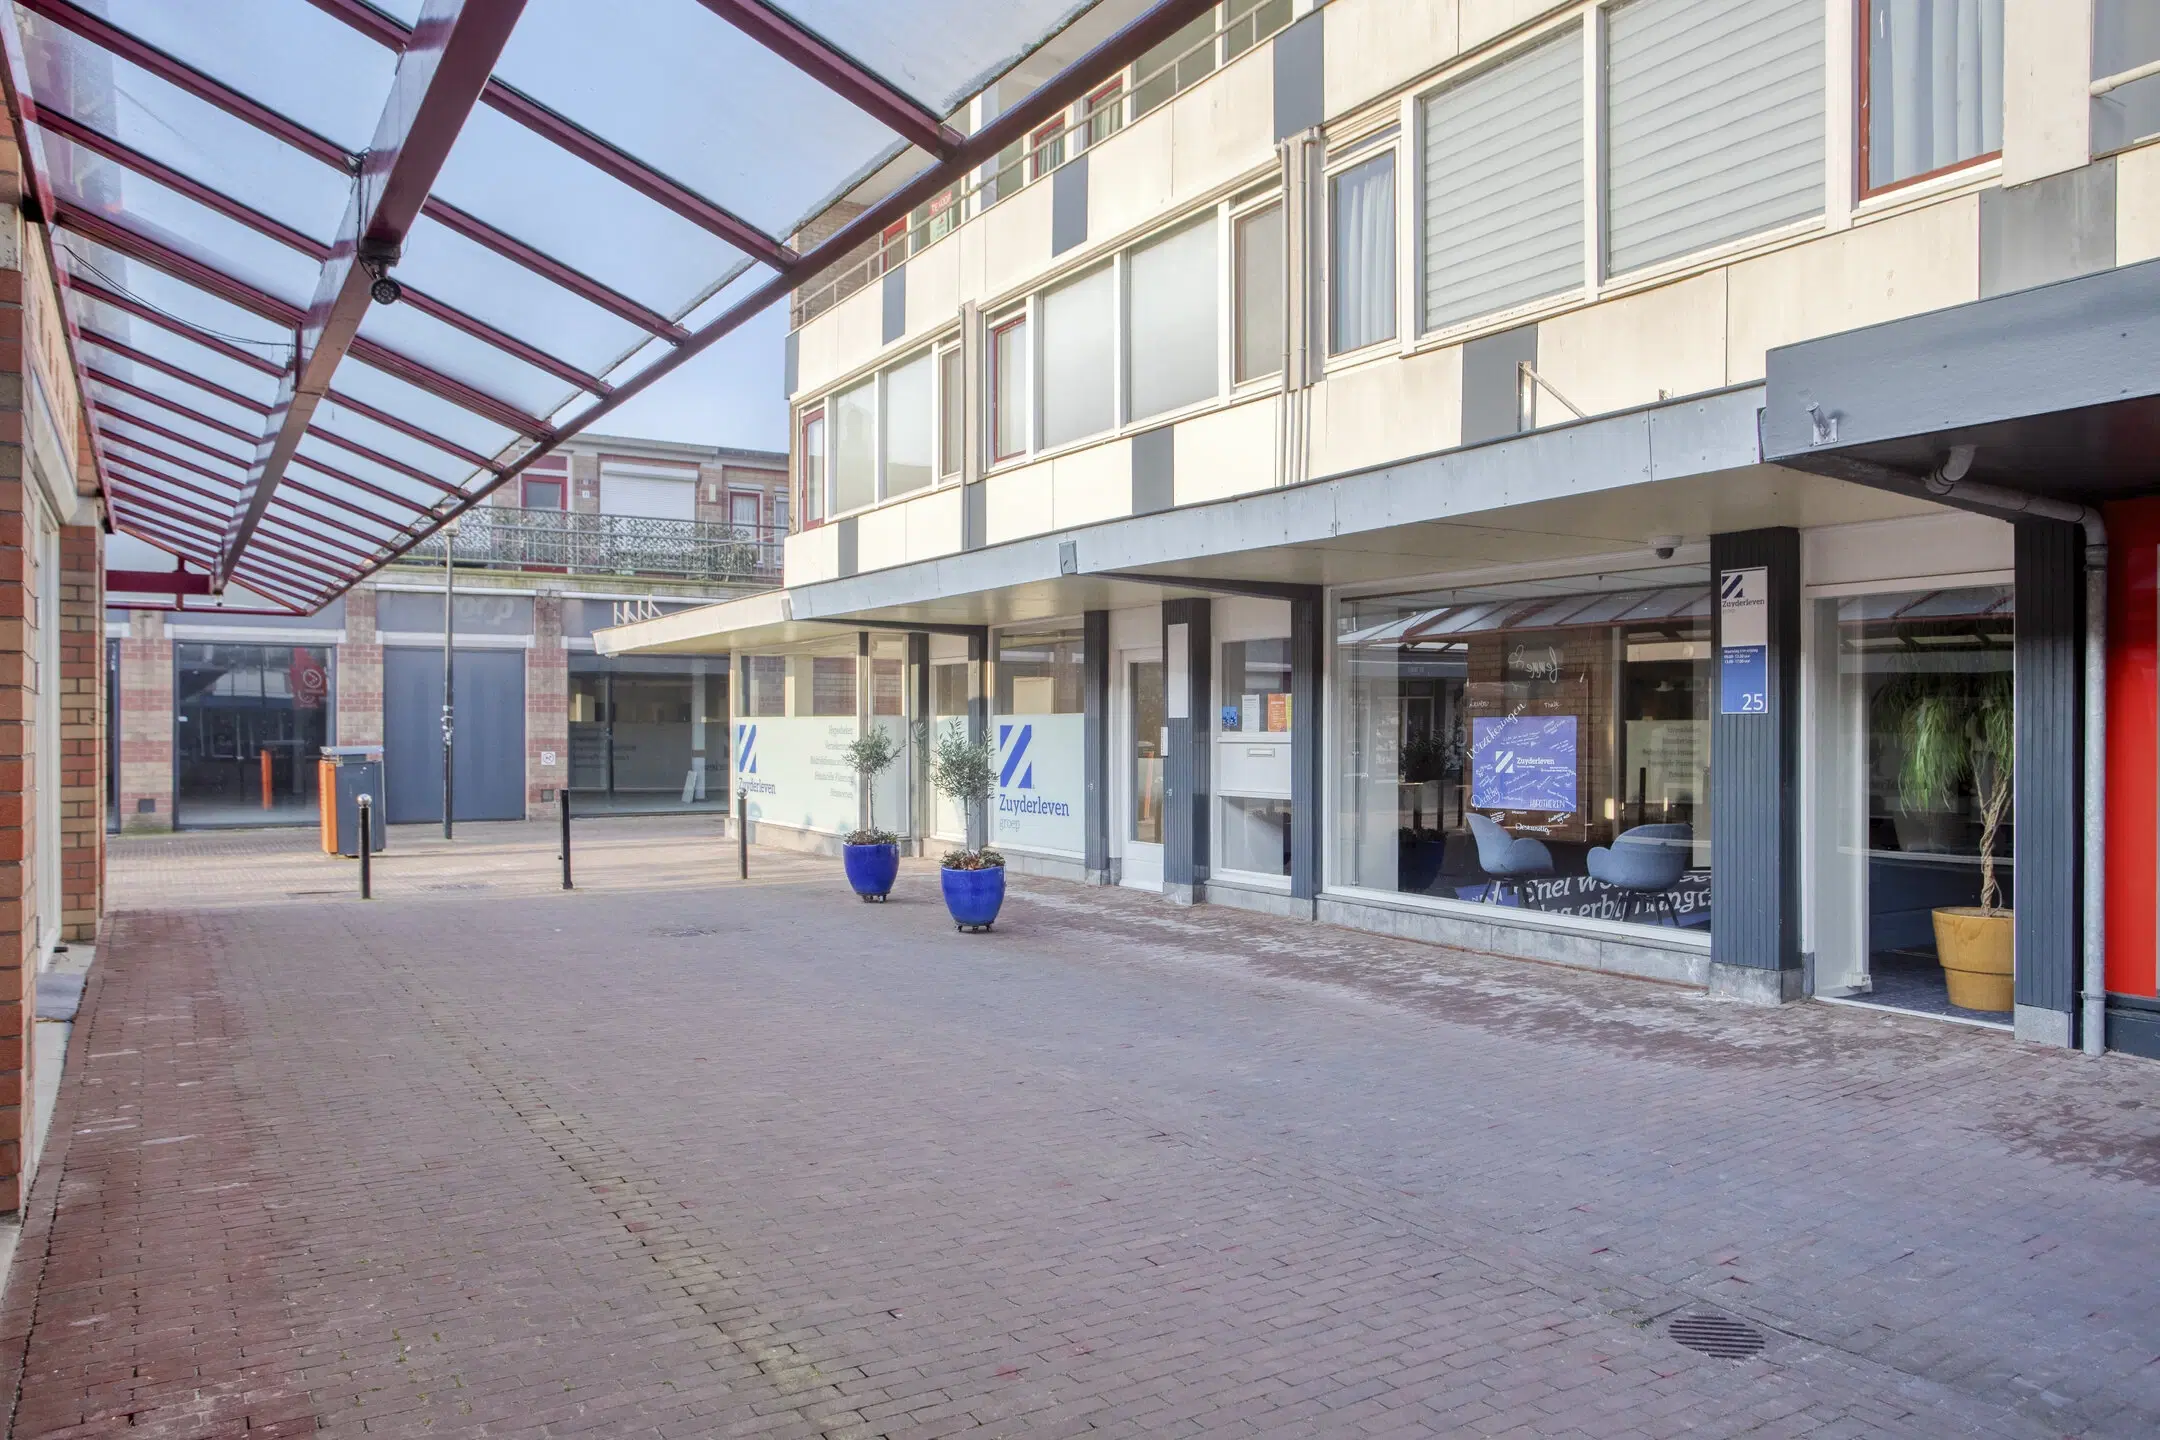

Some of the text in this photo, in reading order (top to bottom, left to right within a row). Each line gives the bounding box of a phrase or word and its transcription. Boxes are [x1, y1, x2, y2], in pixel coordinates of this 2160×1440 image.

[1722, 598, 1765, 608] Zuyderleven
[1742, 693, 1764, 711] 25
[1516, 756, 1555, 766] Zuyderleven
[999, 793, 1070, 817] Zuyderleven
[999, 818, 1021, 832] groep
